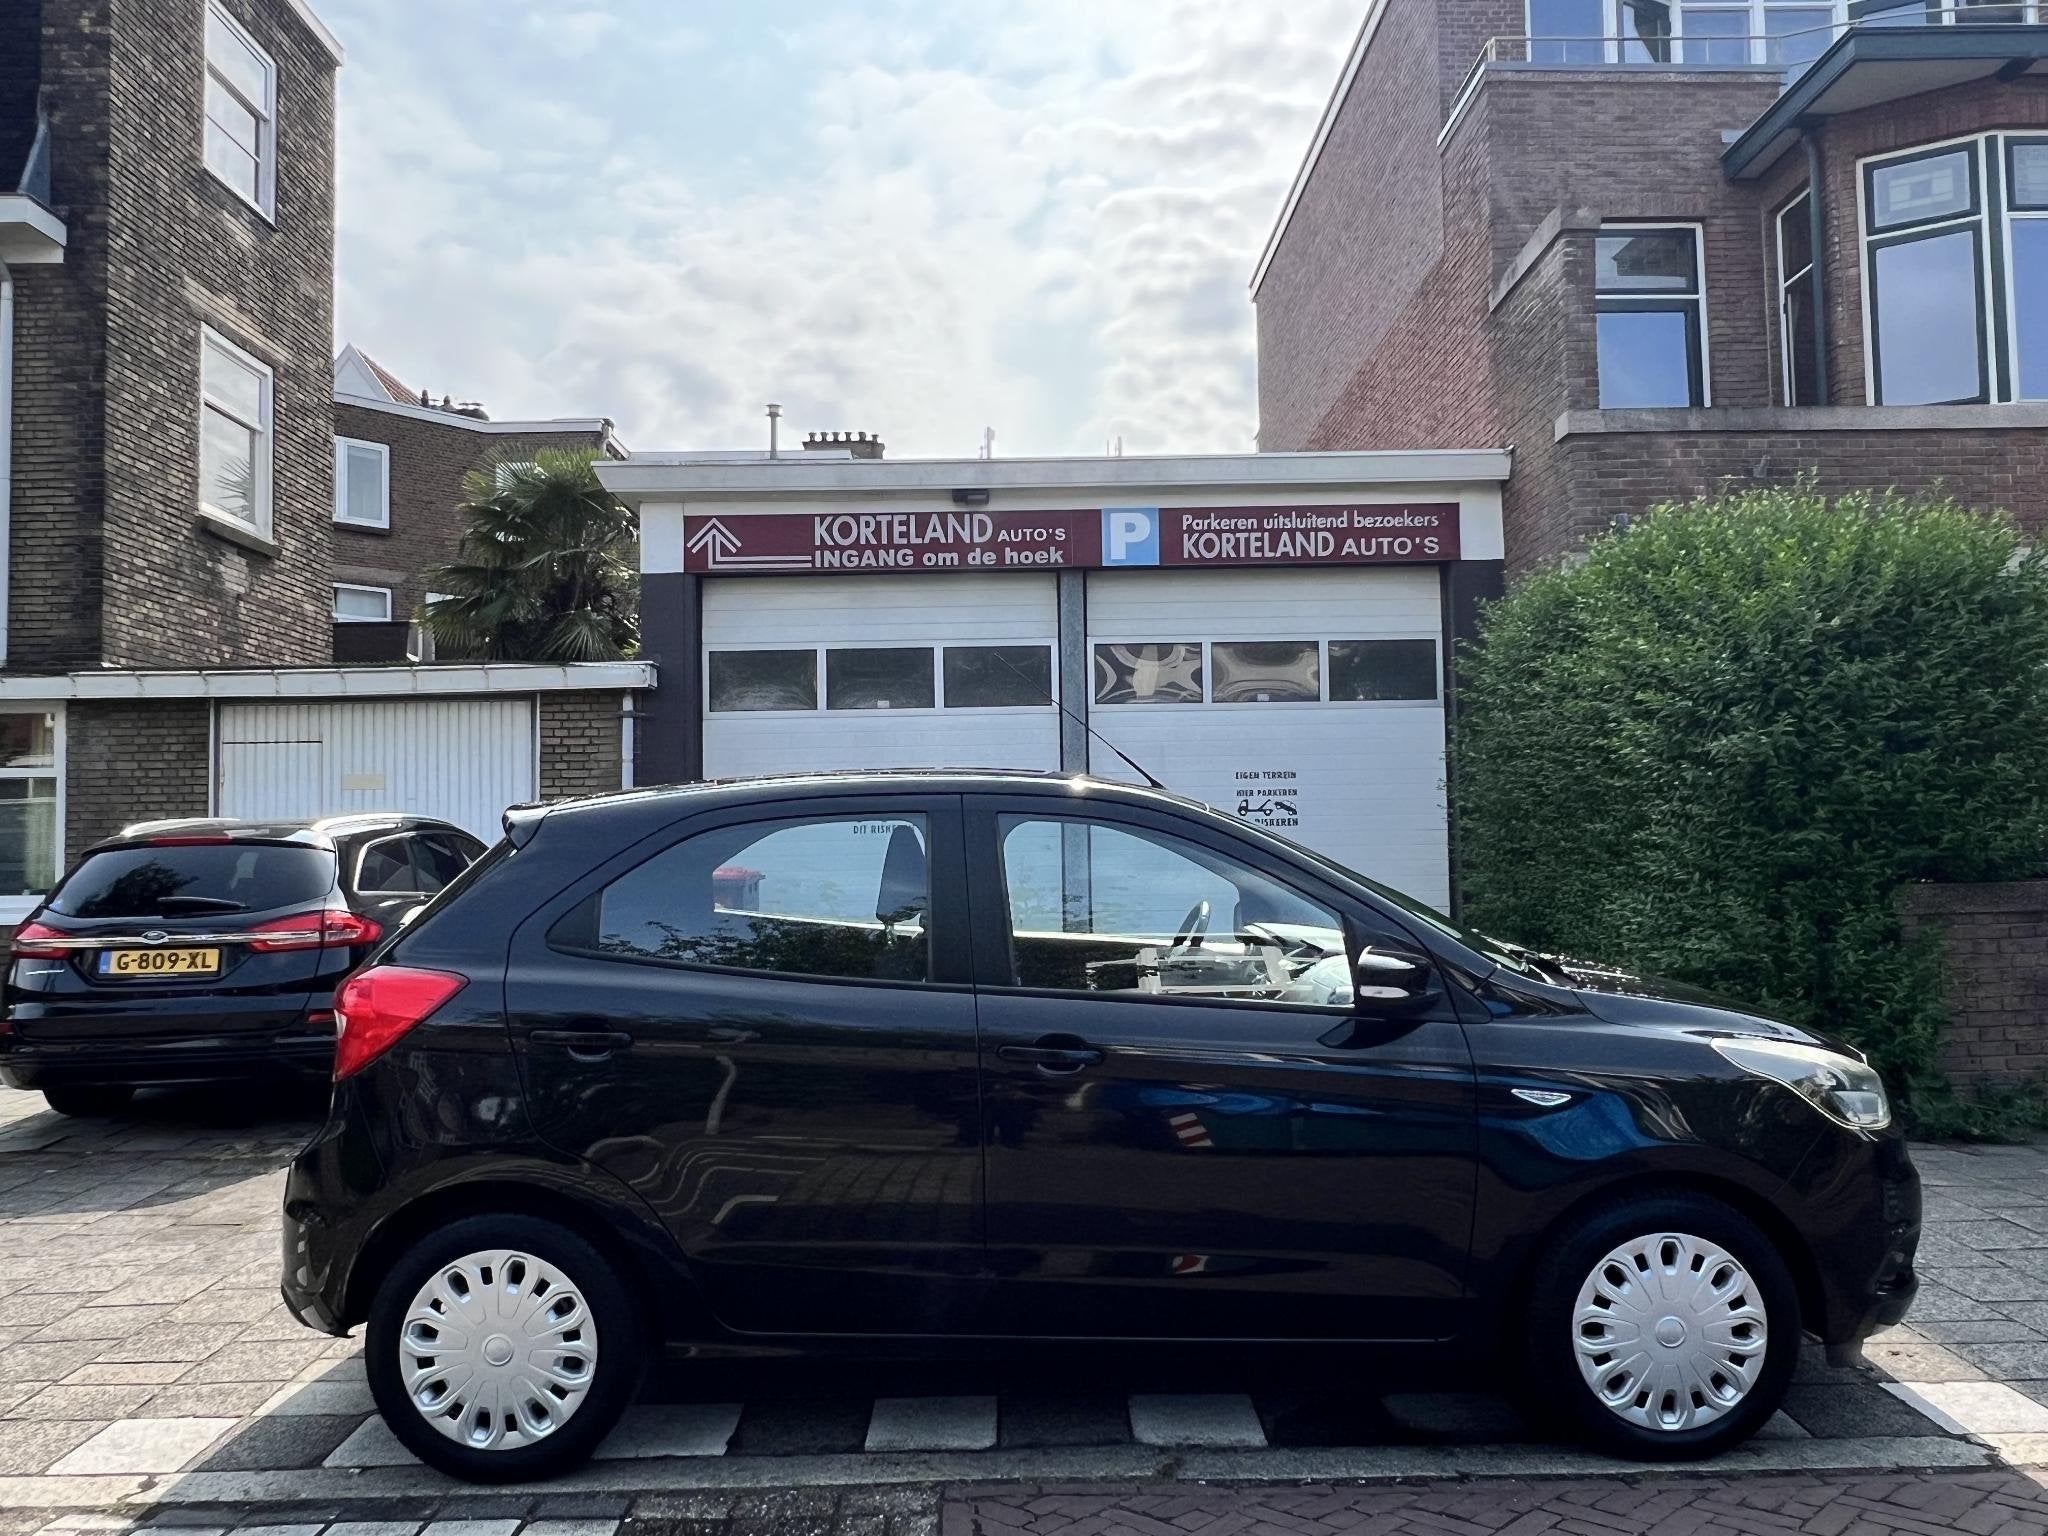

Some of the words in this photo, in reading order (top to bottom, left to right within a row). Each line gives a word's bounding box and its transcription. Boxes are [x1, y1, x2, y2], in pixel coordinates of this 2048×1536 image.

[814, 513, 994, 546] KORTELAND
[998, 527, 1066, 543] AUTO'S
[1182, 513, 1258, 531] Parkeren
[1263, 511, 1348, 529] uitsluitend
[1353, 510, 1439, 528] bezoekers
[1109, 512, 1151, 560] P
[1183, 531, 1336, 559] KORTELAND
[1341, 536, 1440, 556] AUTO'S
[815, 548, 914, 569] INGANG
[922, 551, 960, 566] om
[967, 549, 998, 566] de
[1004, 546, 1065, 565] hoek
[1235, 771, 1260, 780] EIGEN
[1262, 771, 1297, 780] TERREIN
[871, 825, 896, 834] RISK
[116, 951, 212, 971] G-809-XL
